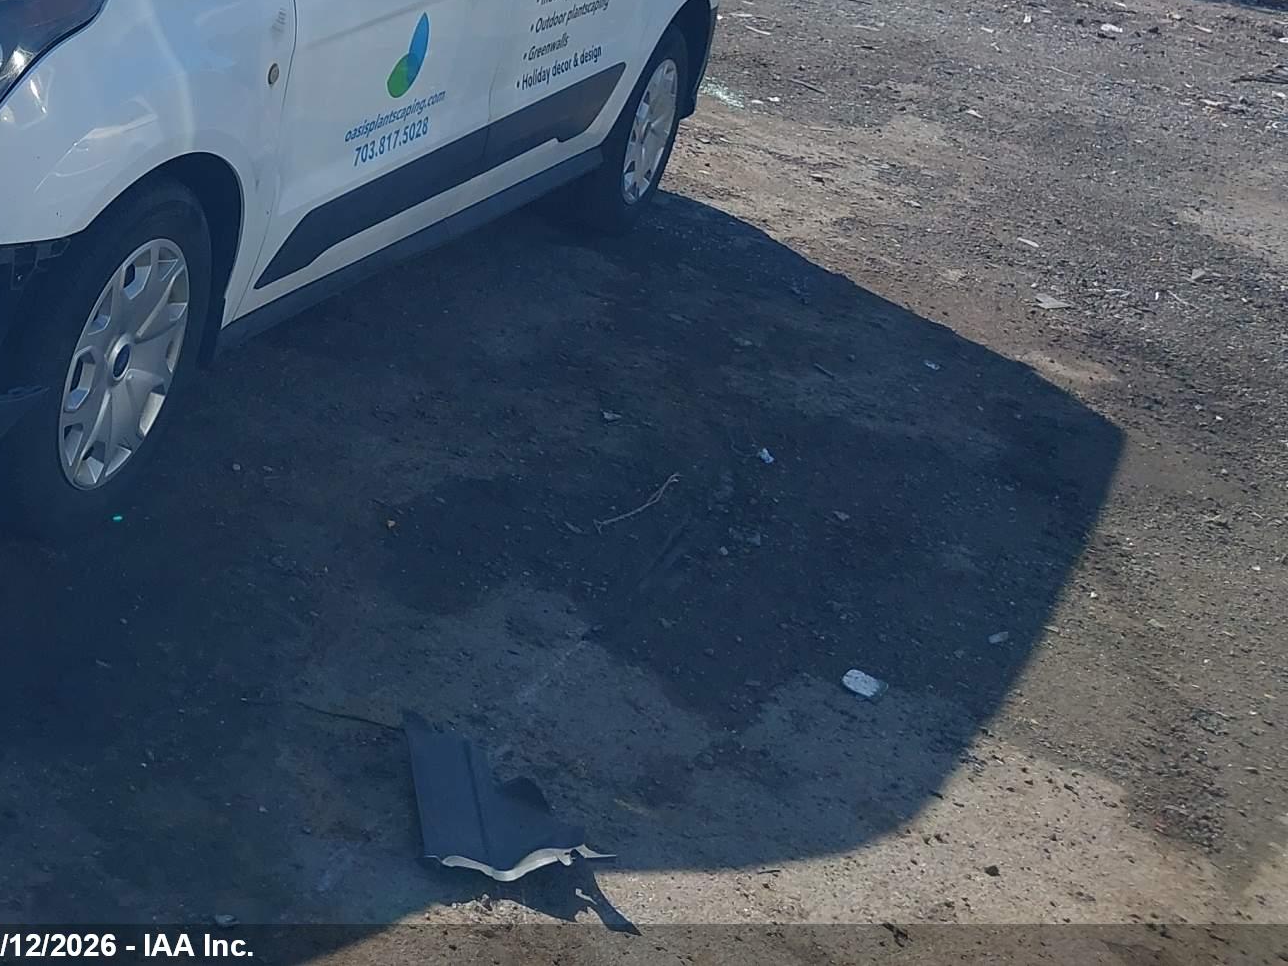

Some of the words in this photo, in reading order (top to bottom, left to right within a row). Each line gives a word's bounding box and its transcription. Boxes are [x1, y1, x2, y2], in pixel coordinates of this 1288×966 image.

[535, 10, 567, 33] Outdoor
[522, 65, 551, 91] Holiday
[552, 60, 572, 77] decor
[573, 53, 579, 68] &
[580, 44, 602, 65] design
[527, 32, 570, 61] Greenwalls
[344, 90, 446, 143] oasisplantscaping.com
[353, 116, 429, 167] 703.817.5028
